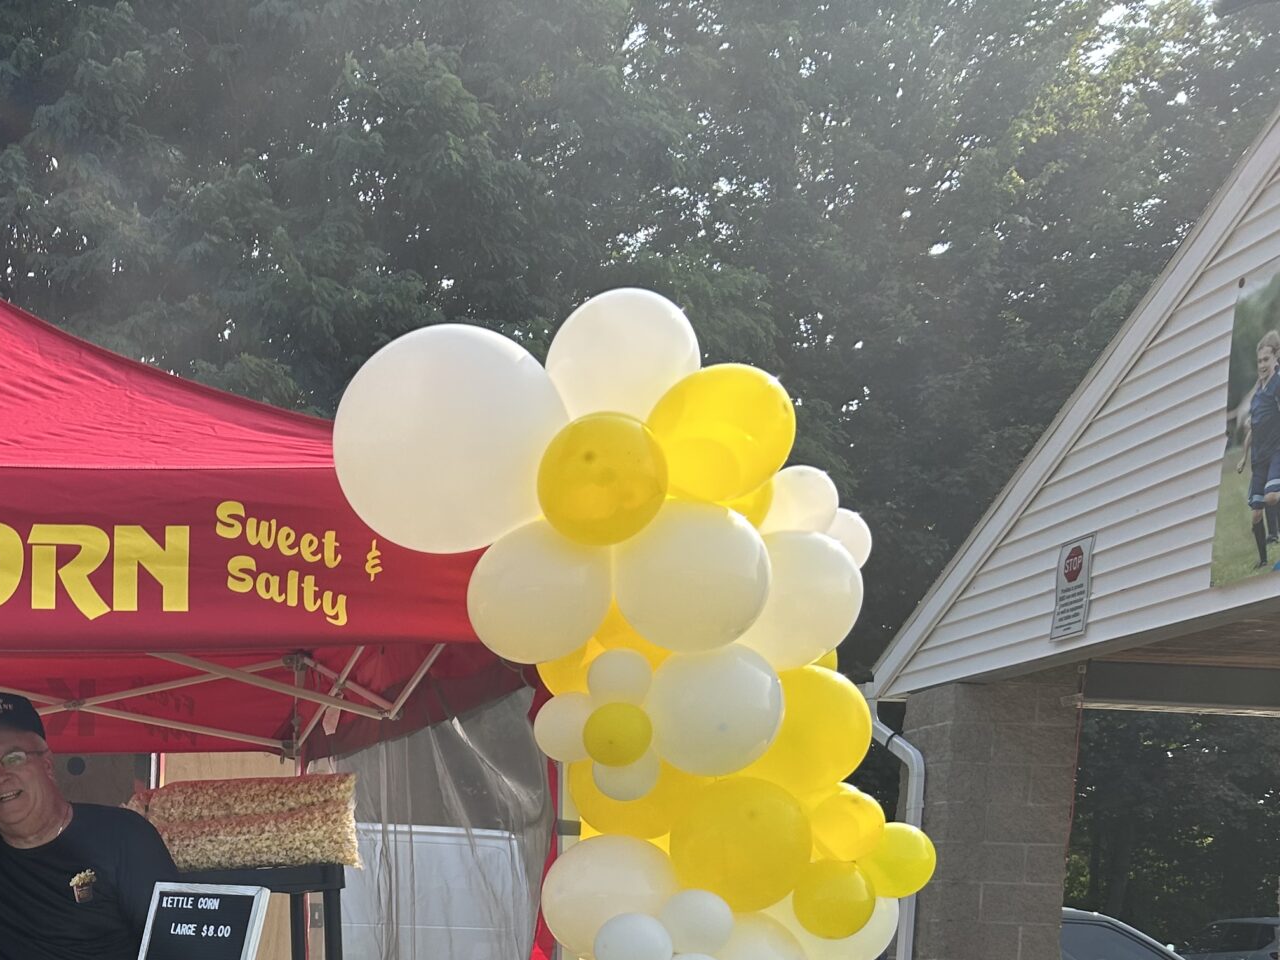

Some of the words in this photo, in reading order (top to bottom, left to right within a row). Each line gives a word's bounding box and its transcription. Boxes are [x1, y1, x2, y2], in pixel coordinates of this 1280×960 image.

[215, 501, 343, 567] Sweet
[365, 539, 384, 582] &
[1065, 556, 1082, 573] STOP
[226, 556, 349, 627] Salty
[162, 896, 194, 909] KETTLE
[198, 898, 220, 910] CORN
[170, 923, 197, 936] LARGE
[201, 925, 231, 938] $8.00
